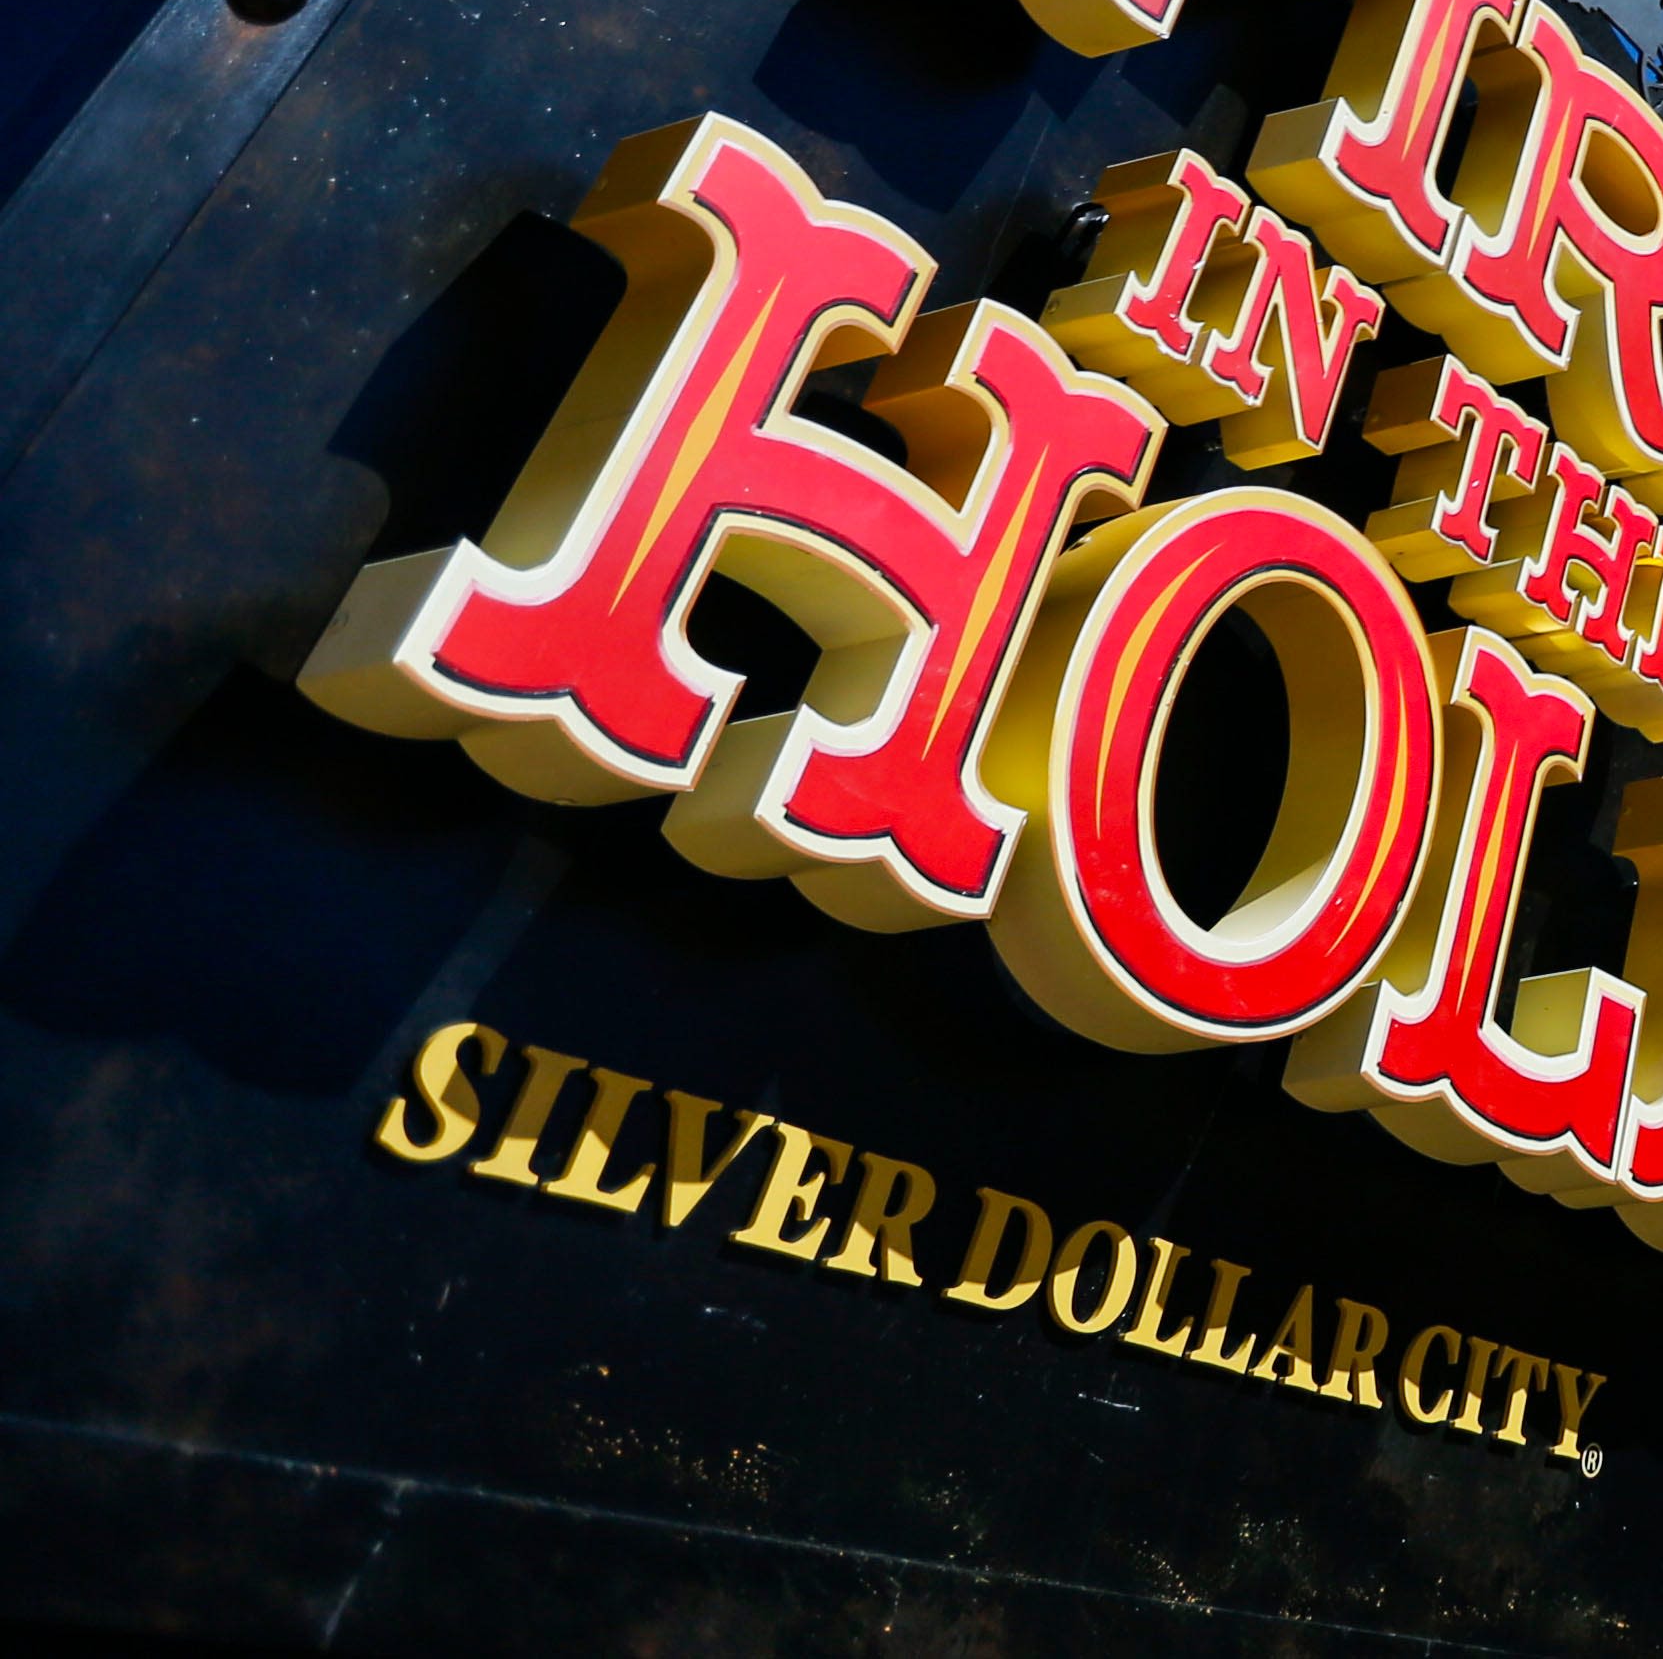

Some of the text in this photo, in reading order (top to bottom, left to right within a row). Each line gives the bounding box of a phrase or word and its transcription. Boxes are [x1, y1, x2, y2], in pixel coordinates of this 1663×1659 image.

[1120, 148, 1381, 461] IN
[374, 1021, 937, 1287] SILVER
[941, 1187, 1389, 1409] DOLLAR
